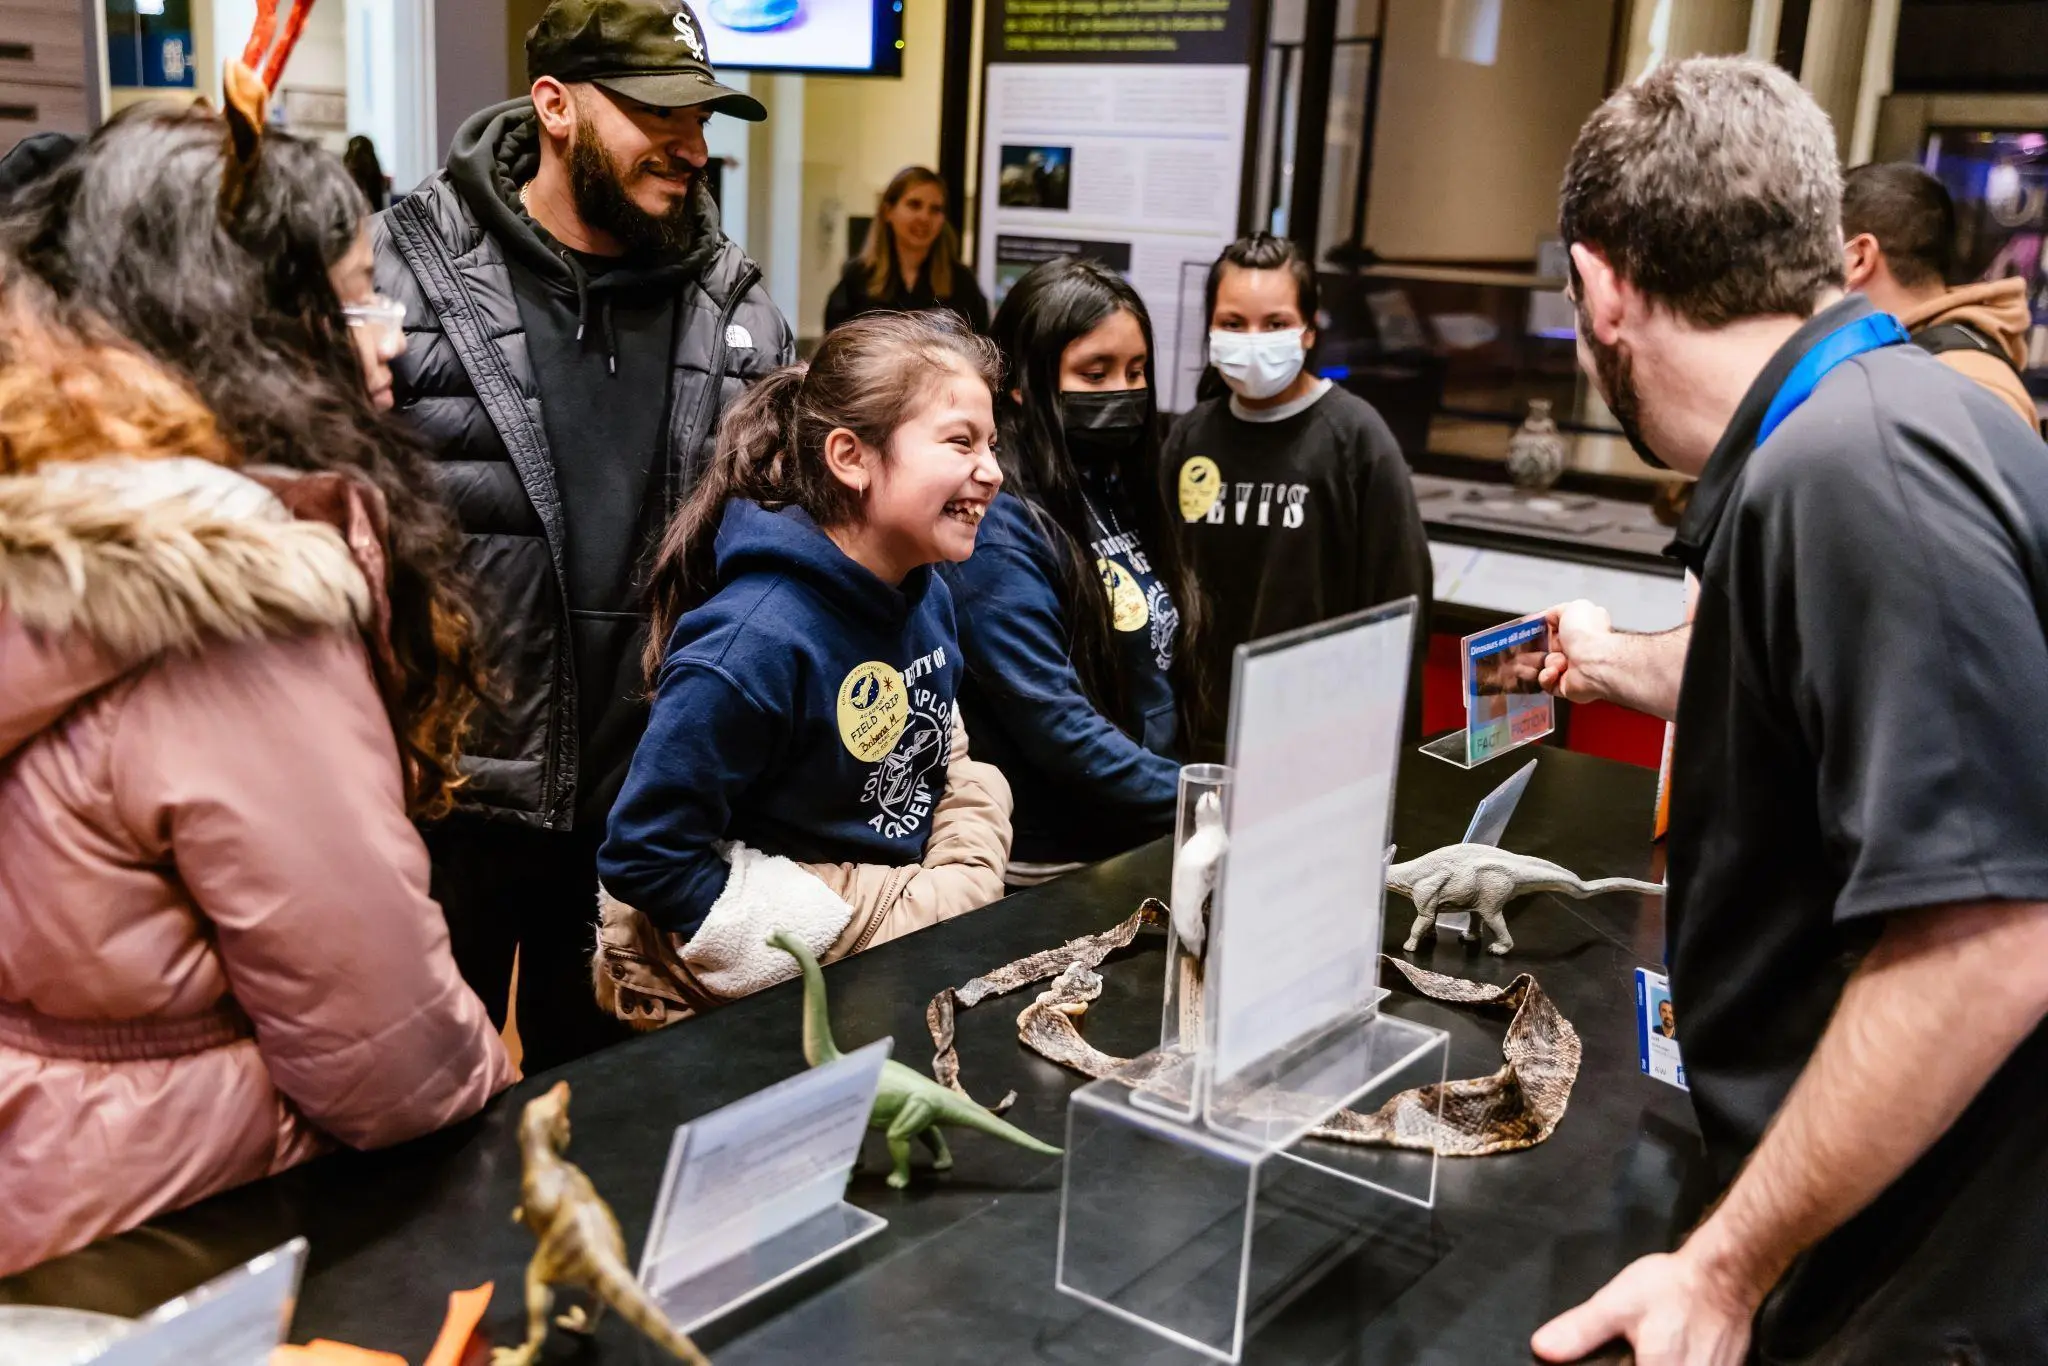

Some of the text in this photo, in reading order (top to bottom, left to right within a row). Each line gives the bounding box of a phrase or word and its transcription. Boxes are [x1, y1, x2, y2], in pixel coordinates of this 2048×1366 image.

[672, 12, 704, 61] Sox
[1184, 482, 1310, 529] EVI'S
[1470, 639, 1499, 656] Dinosaurs
[850, 693, 900, 743] FIELD TRIP
[1476, 731, 1502, 753] FACT
[868, 776, 932, 839] ACADEMY
